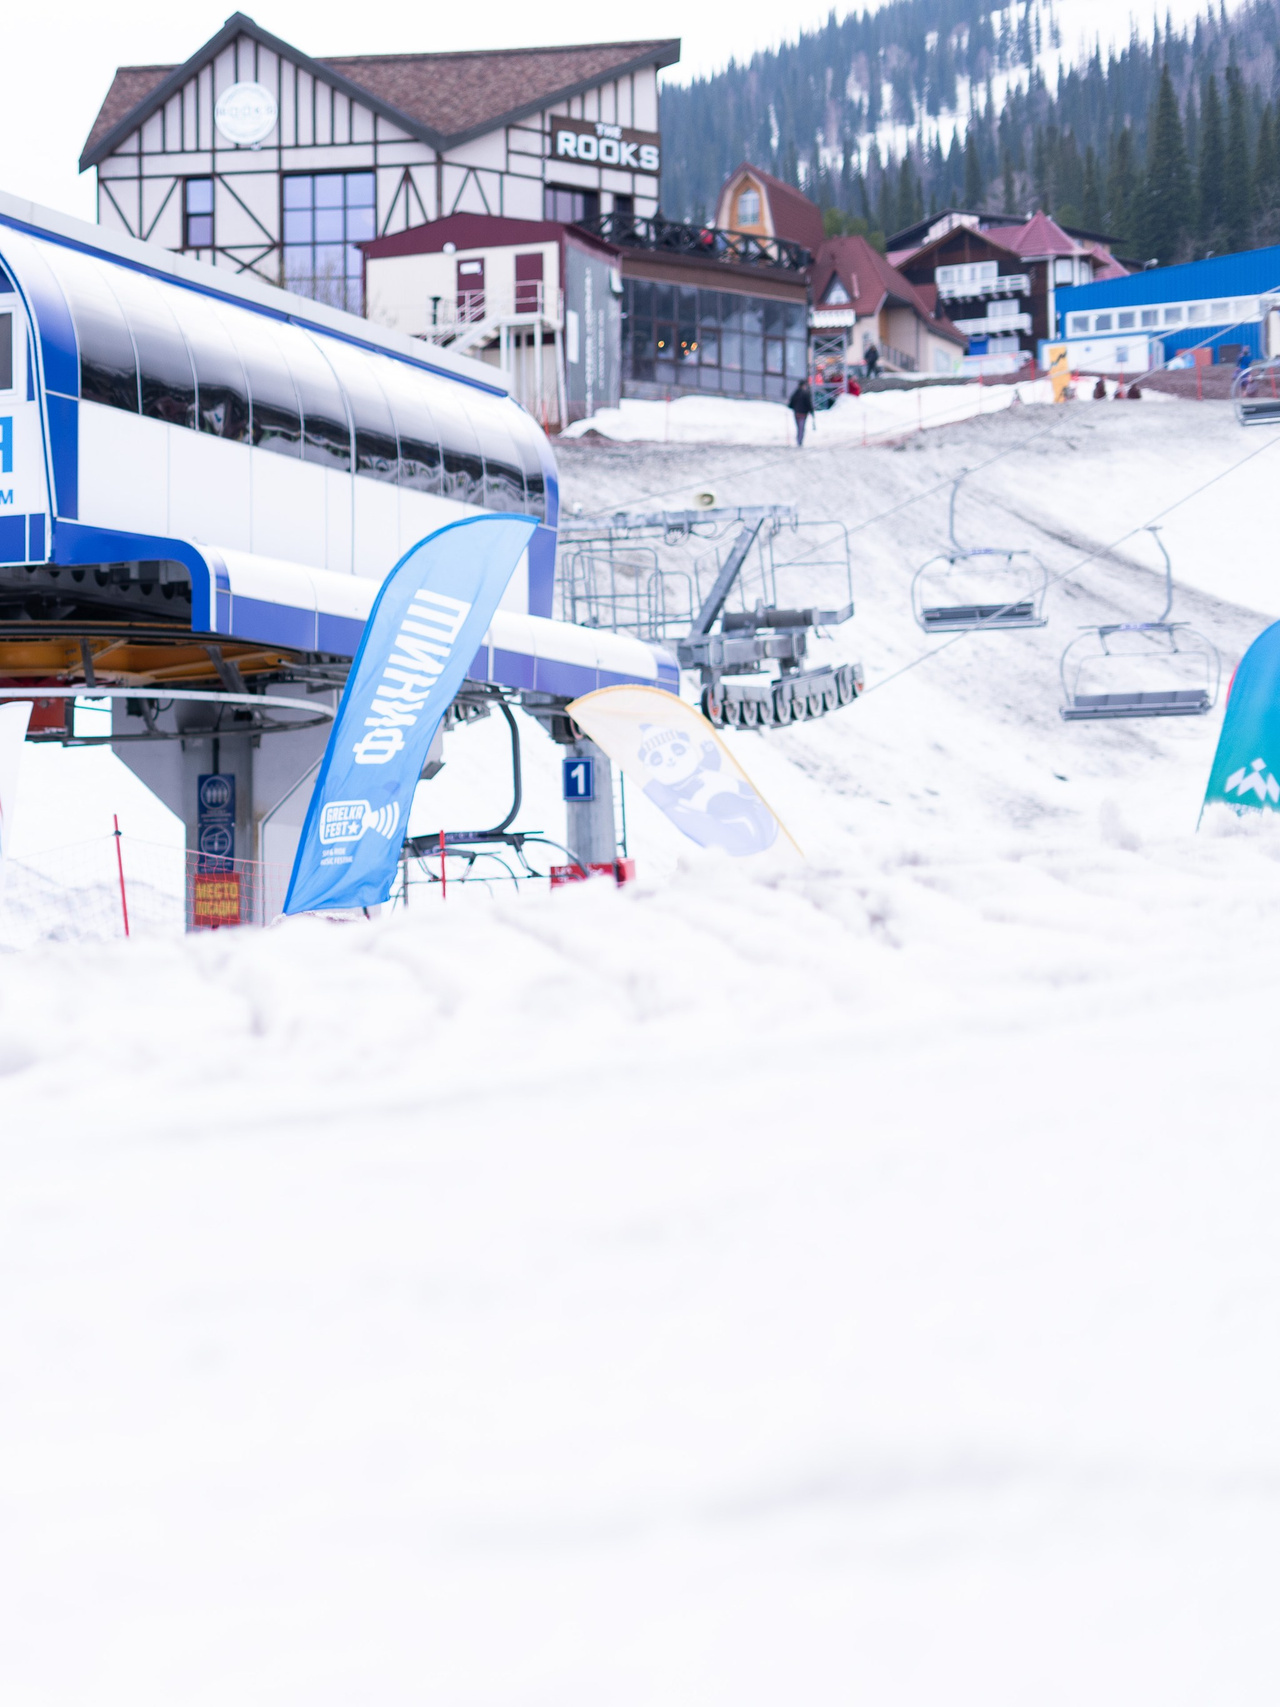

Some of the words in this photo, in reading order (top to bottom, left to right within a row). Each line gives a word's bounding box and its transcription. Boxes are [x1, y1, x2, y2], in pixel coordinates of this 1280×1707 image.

[595, 122, 622, 140] THE
[557, 130, 659, 171] ROOKS
[352, 589, 472, 764] ФИНИШ
[571, 763, 585, 795] 1
[327, 805, 364, 823] GRELKA
[325, 821, 349, 838] FEST
[195, 882, 238, 899] МЕСТО
